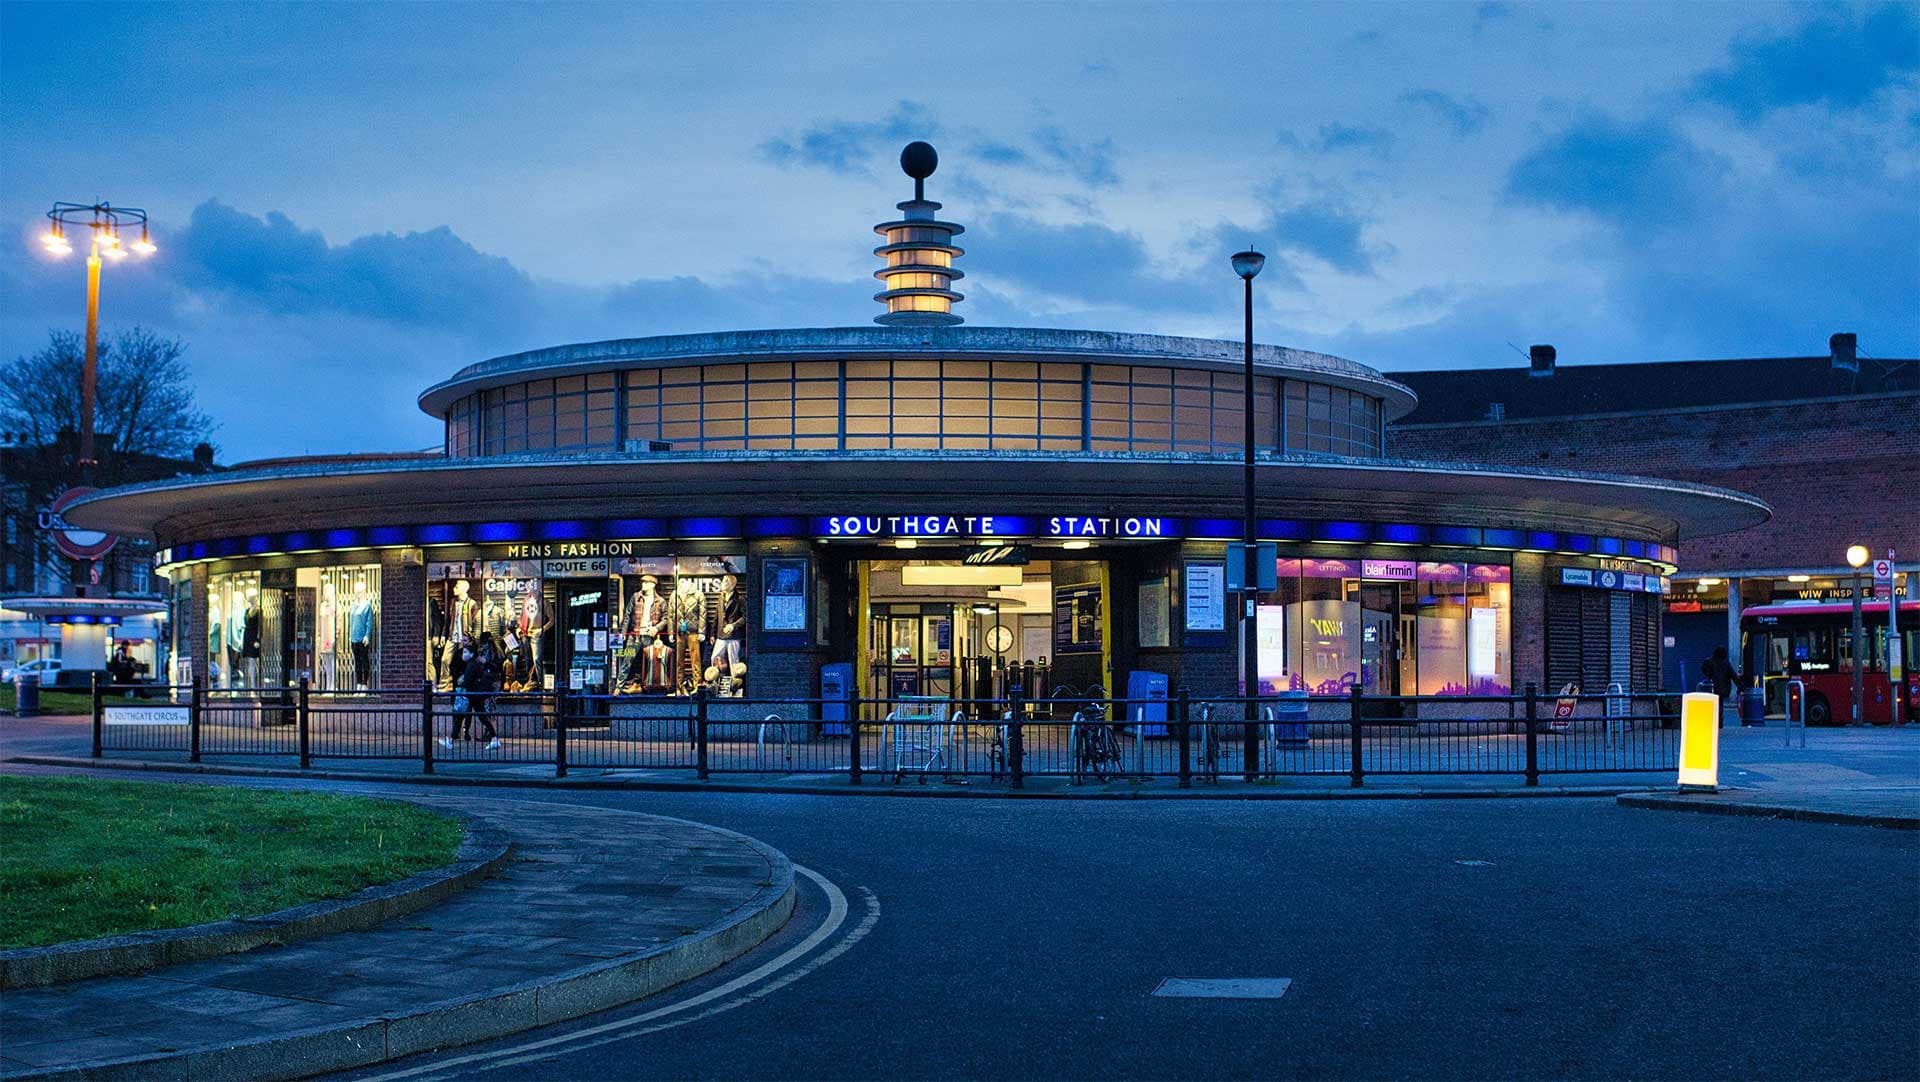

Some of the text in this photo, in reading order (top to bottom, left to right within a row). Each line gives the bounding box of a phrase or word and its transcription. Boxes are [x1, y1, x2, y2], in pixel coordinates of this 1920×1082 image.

[829, 517, 1162, 535] SOUTHGATE STATION
[508, 543, 632, 558] MENS FASHION
[1888, 550, 1896, 559] H
[546, 560, 606, 572] ROUTE 66
[1319, 564, 1346, 572] LETTINGS
[1364, 563, 1413, 577] blainfirmin
[1600, 559, 1635, 572] NEWSAGENT
[1799, 590, 1822, 599] WIW
[1829, 588, 1870, 598] INSPE
[114, 711, 152, 721] SOUTHGATE
[153, 711, 179, 721] CIRCUS
